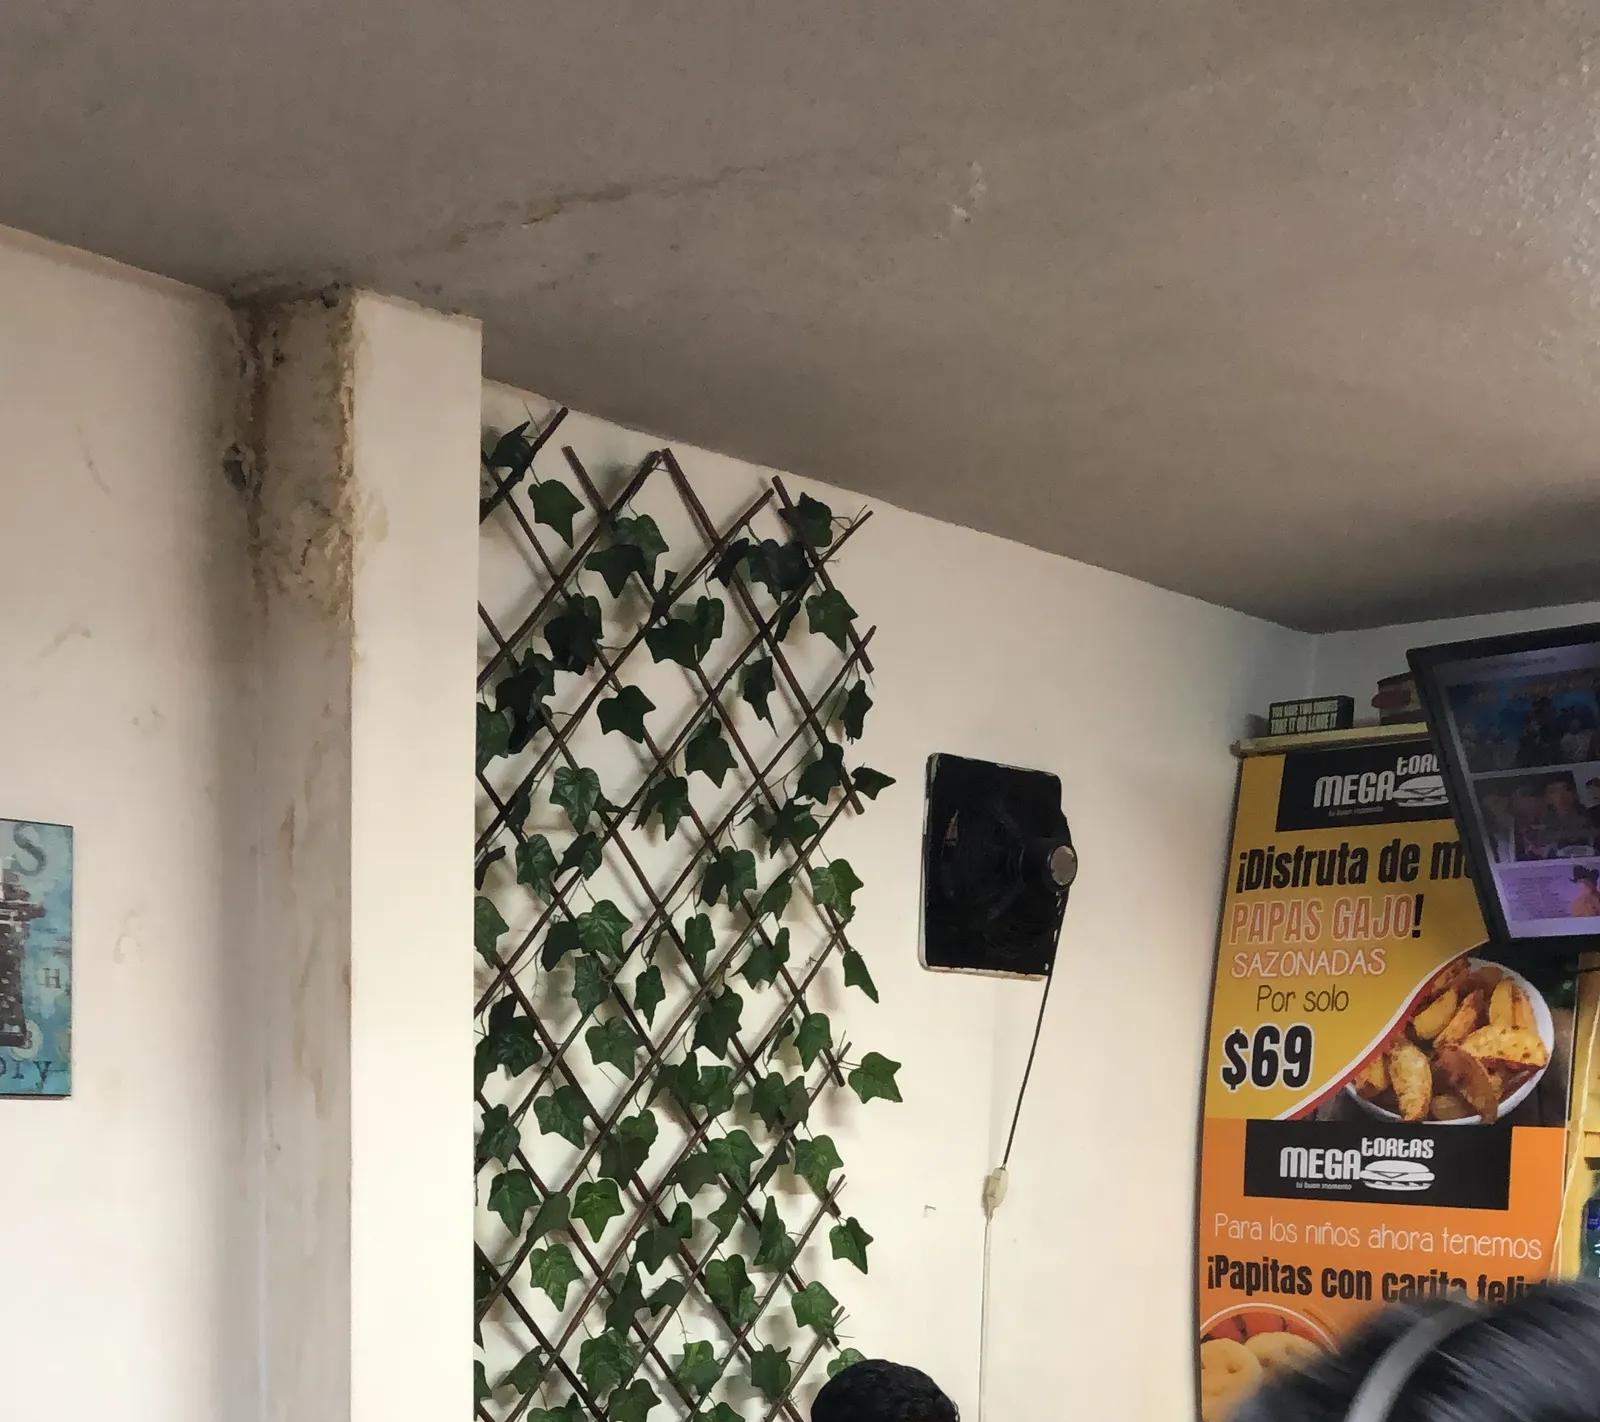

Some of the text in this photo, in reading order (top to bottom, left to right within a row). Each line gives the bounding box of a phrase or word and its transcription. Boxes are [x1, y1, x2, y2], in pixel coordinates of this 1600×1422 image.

[1313, 770, 1395, 808] MEGA
[1378, 838, 1420, 883] de
[1430, 841, 1473, 880] m
[1228, 893, 1425, 945] PAPAS GAJO!
[1231, 948, 1386, 978] SAZONADAS
[1256, 984, 1350, 1012] Por solo
[1221, 1024, 1313, 1091] $69
[1279, 1146, 1361, 1180] MEGA
[1214, 1212, 1543, 1260] Para los niños ahora tenemos
[1207, 1254, 1313, 1297] ¡Papitas
[1321, 1267, 1373, 1301] con
